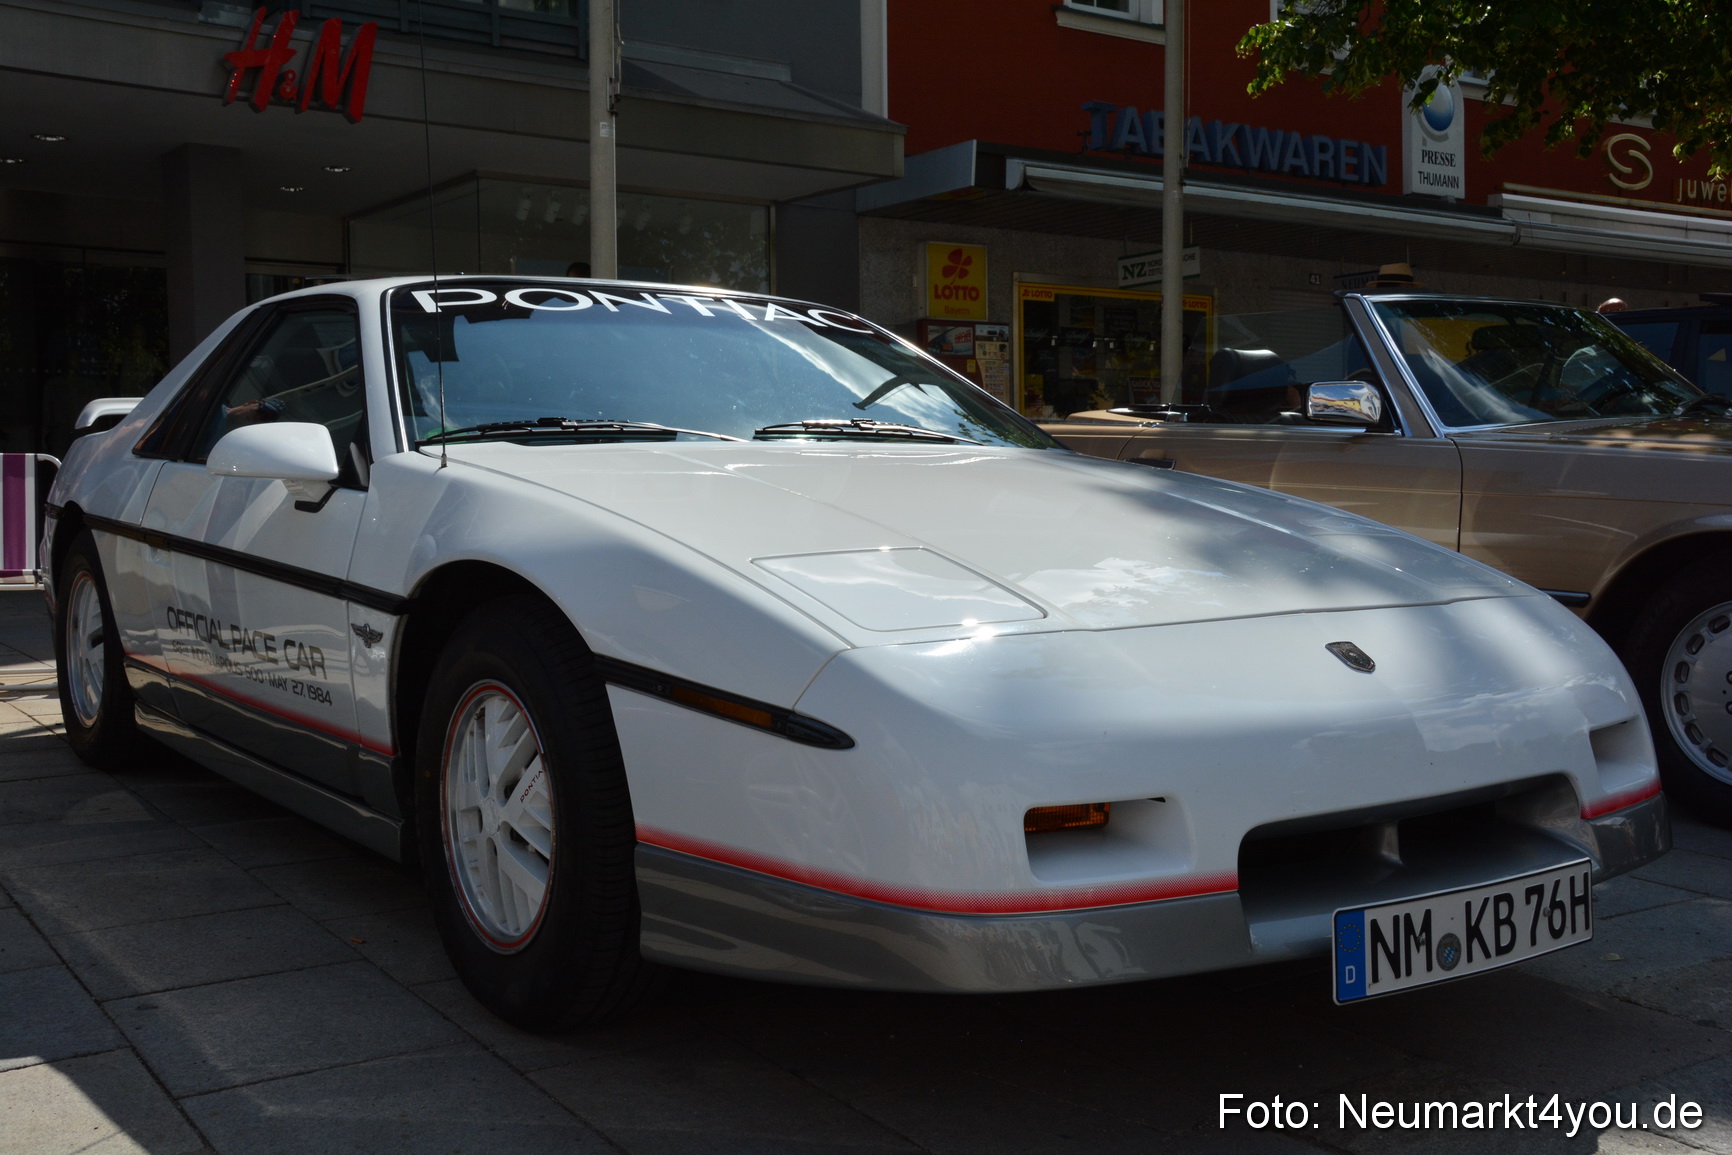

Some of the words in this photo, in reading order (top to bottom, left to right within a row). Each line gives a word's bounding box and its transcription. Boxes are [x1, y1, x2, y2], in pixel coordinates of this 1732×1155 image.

[222, 6, 379, 124] H&M
[1421, 149, 1457, 168] PRESSE
[1417, 170, 1460, 190] THUMANN
[1121, 261, 1147, 281] NZ
[1309, 274, 1321, 285] 41
[933, 283, 981, 302] LOTTO
[1031, 289, 1053, 299] LOTTO
[410, 287, 876, 336] PONTIAC
[943, 304, 971, 317] Bayern
[1188, 300, 1208, 310] LOTTO
[167, 607, 230, 650] OFFICIAL
[231, 625, 279, 665] PACE
[284, 640, 328, 680] CAR
[269, 674, 287, 691] MAY
[1369, 908, 1434, 984] NM
[1464, 892, 1518, 963] KB
[1525, 871, 1591, 947] 76H
[1344, 964, 1356, 984] D
